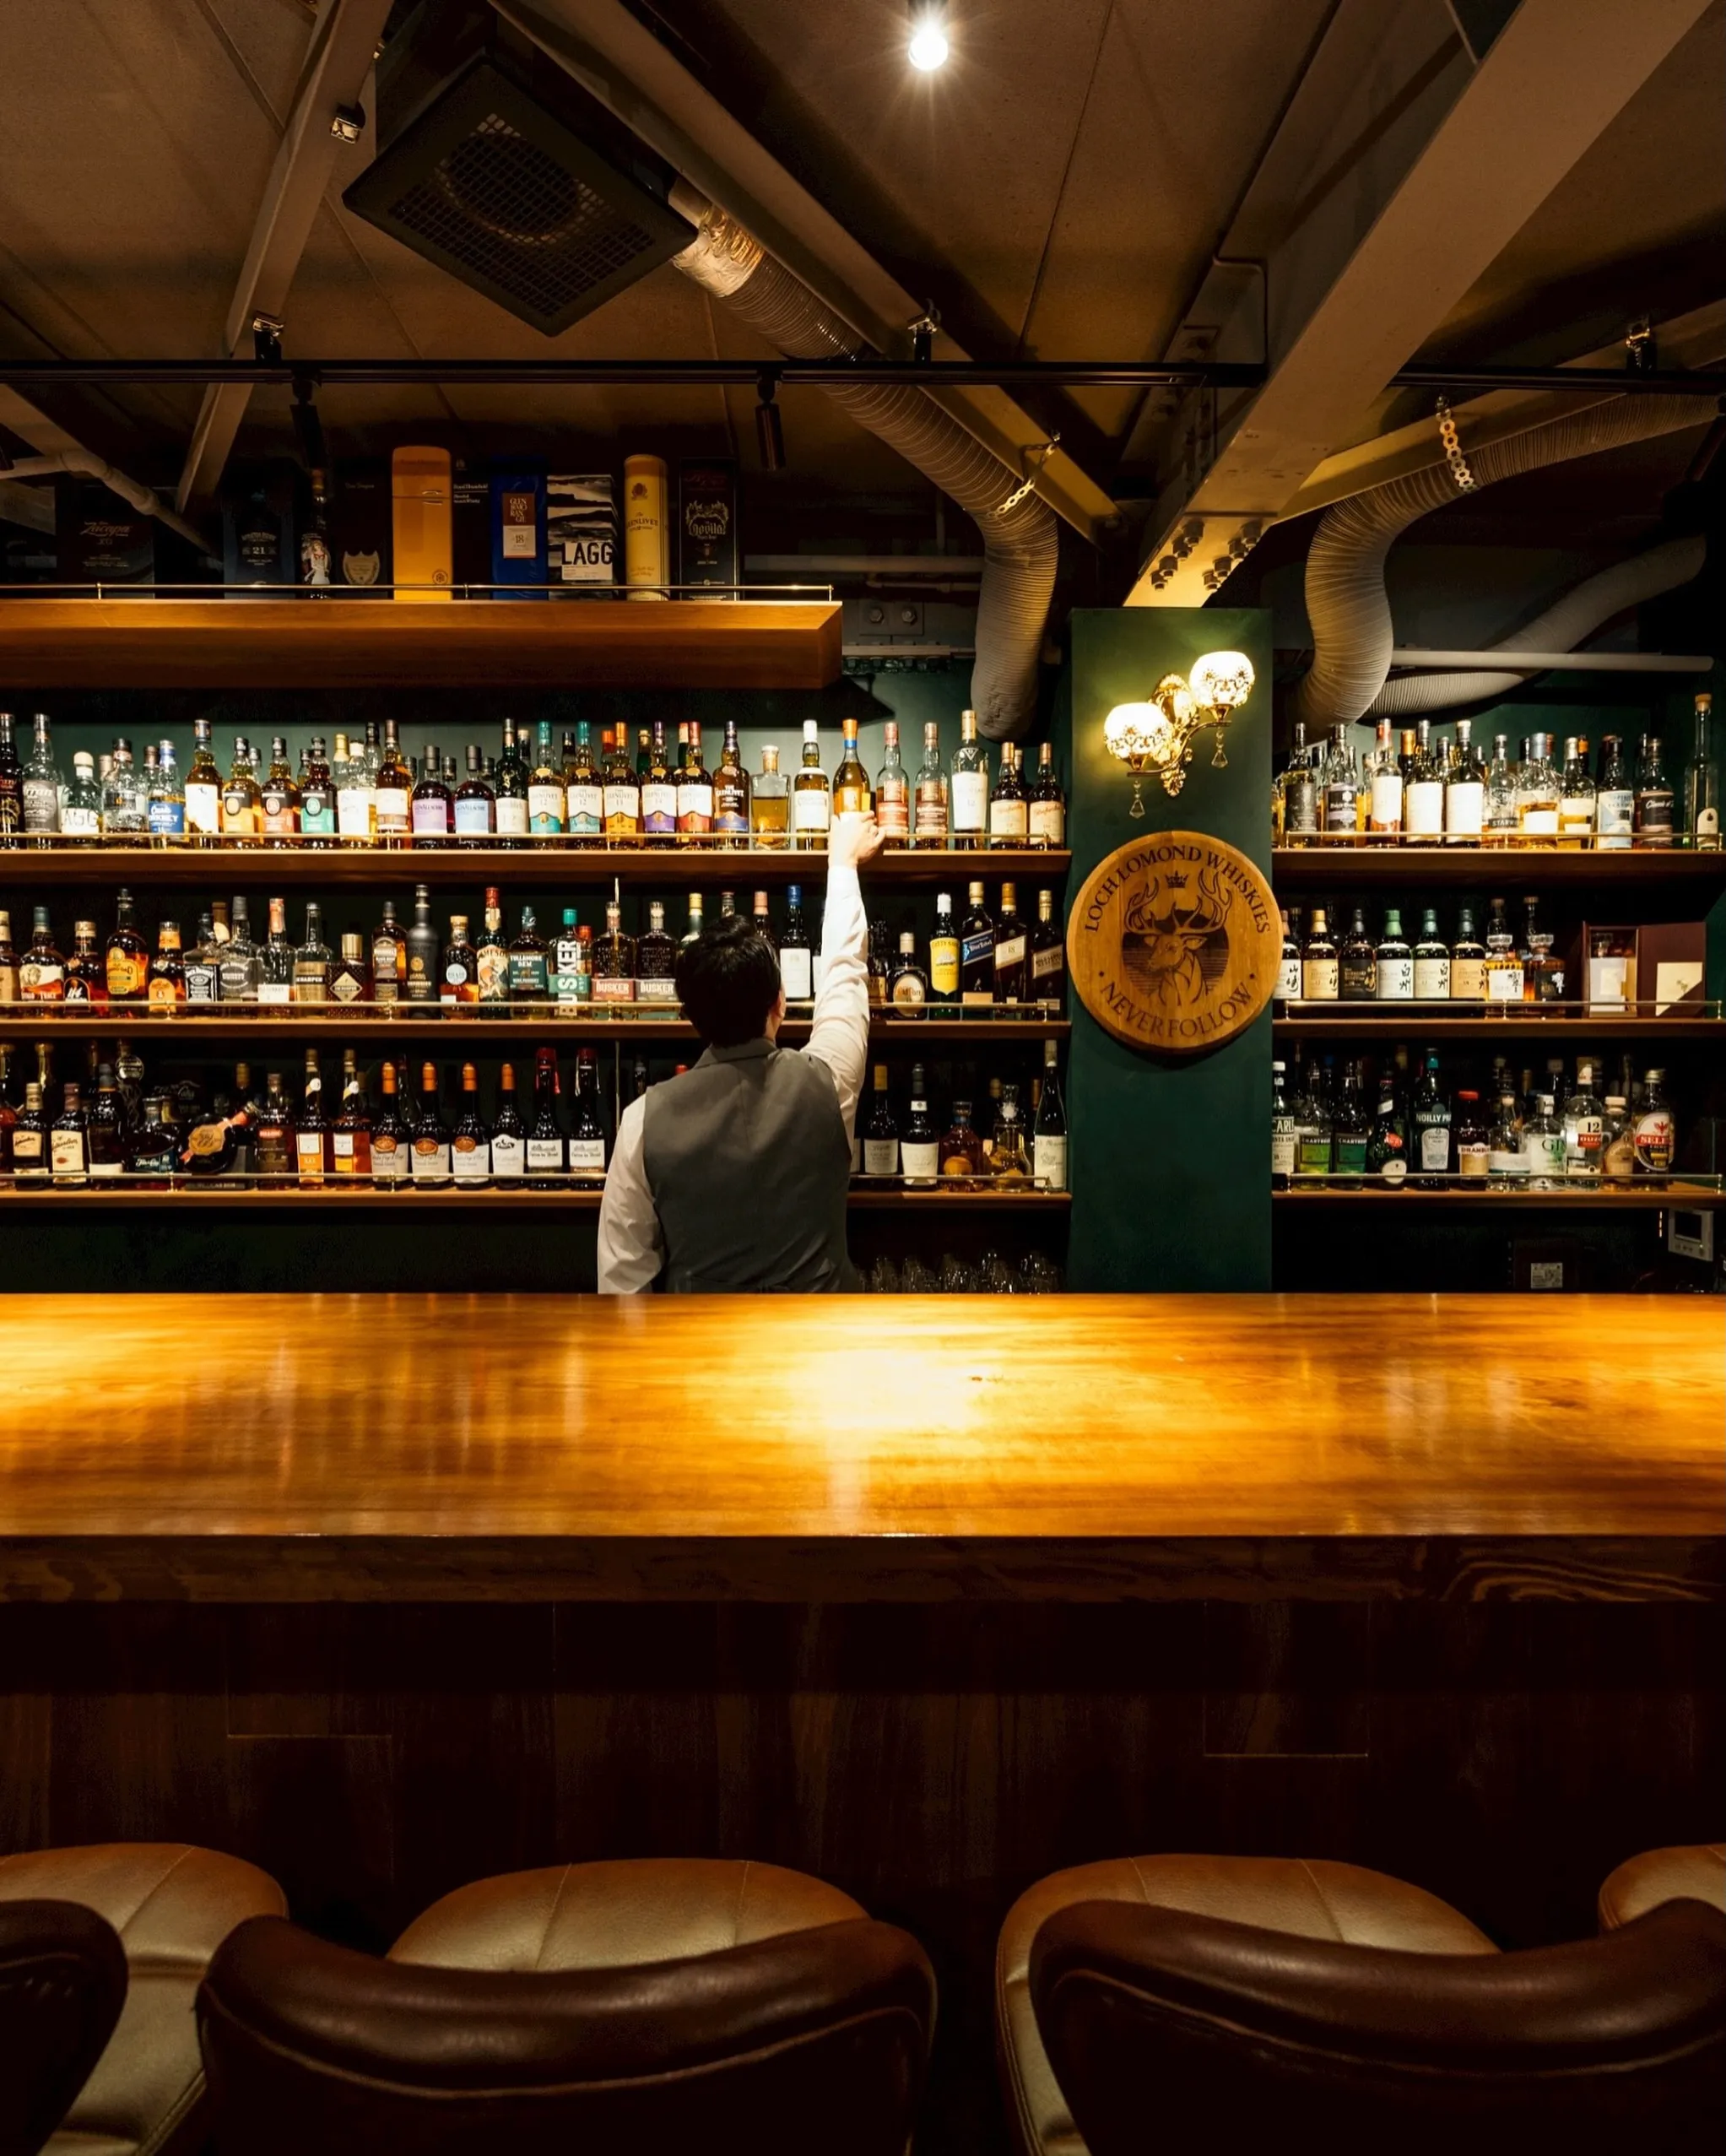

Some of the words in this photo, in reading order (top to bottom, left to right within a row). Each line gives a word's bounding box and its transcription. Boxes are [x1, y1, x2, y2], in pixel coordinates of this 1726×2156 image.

[79, 520, 133, 538] Zacapa
[252, 546, 266, 555] 21
[562, 542, 614, 566] LAGG
[1085, 880, 1120, 933] LOCH
[1116, 844, 1203, 883] LOMOND
[1207, 851, 1271, 934] WHISKIES
[509, 954, 543, 962] TULLAMORE
[596, 981, 630, 994] BUSKER
[640, 981, 674, 994] BUSKER
[1099, 981, 1165, 1037] NEVER
[1167, 981, 1253, 1038] FOLLOW
[1415, 1113, 1442, 1123] NOILLY
[1587, 1121, 1600, 1133] 12
